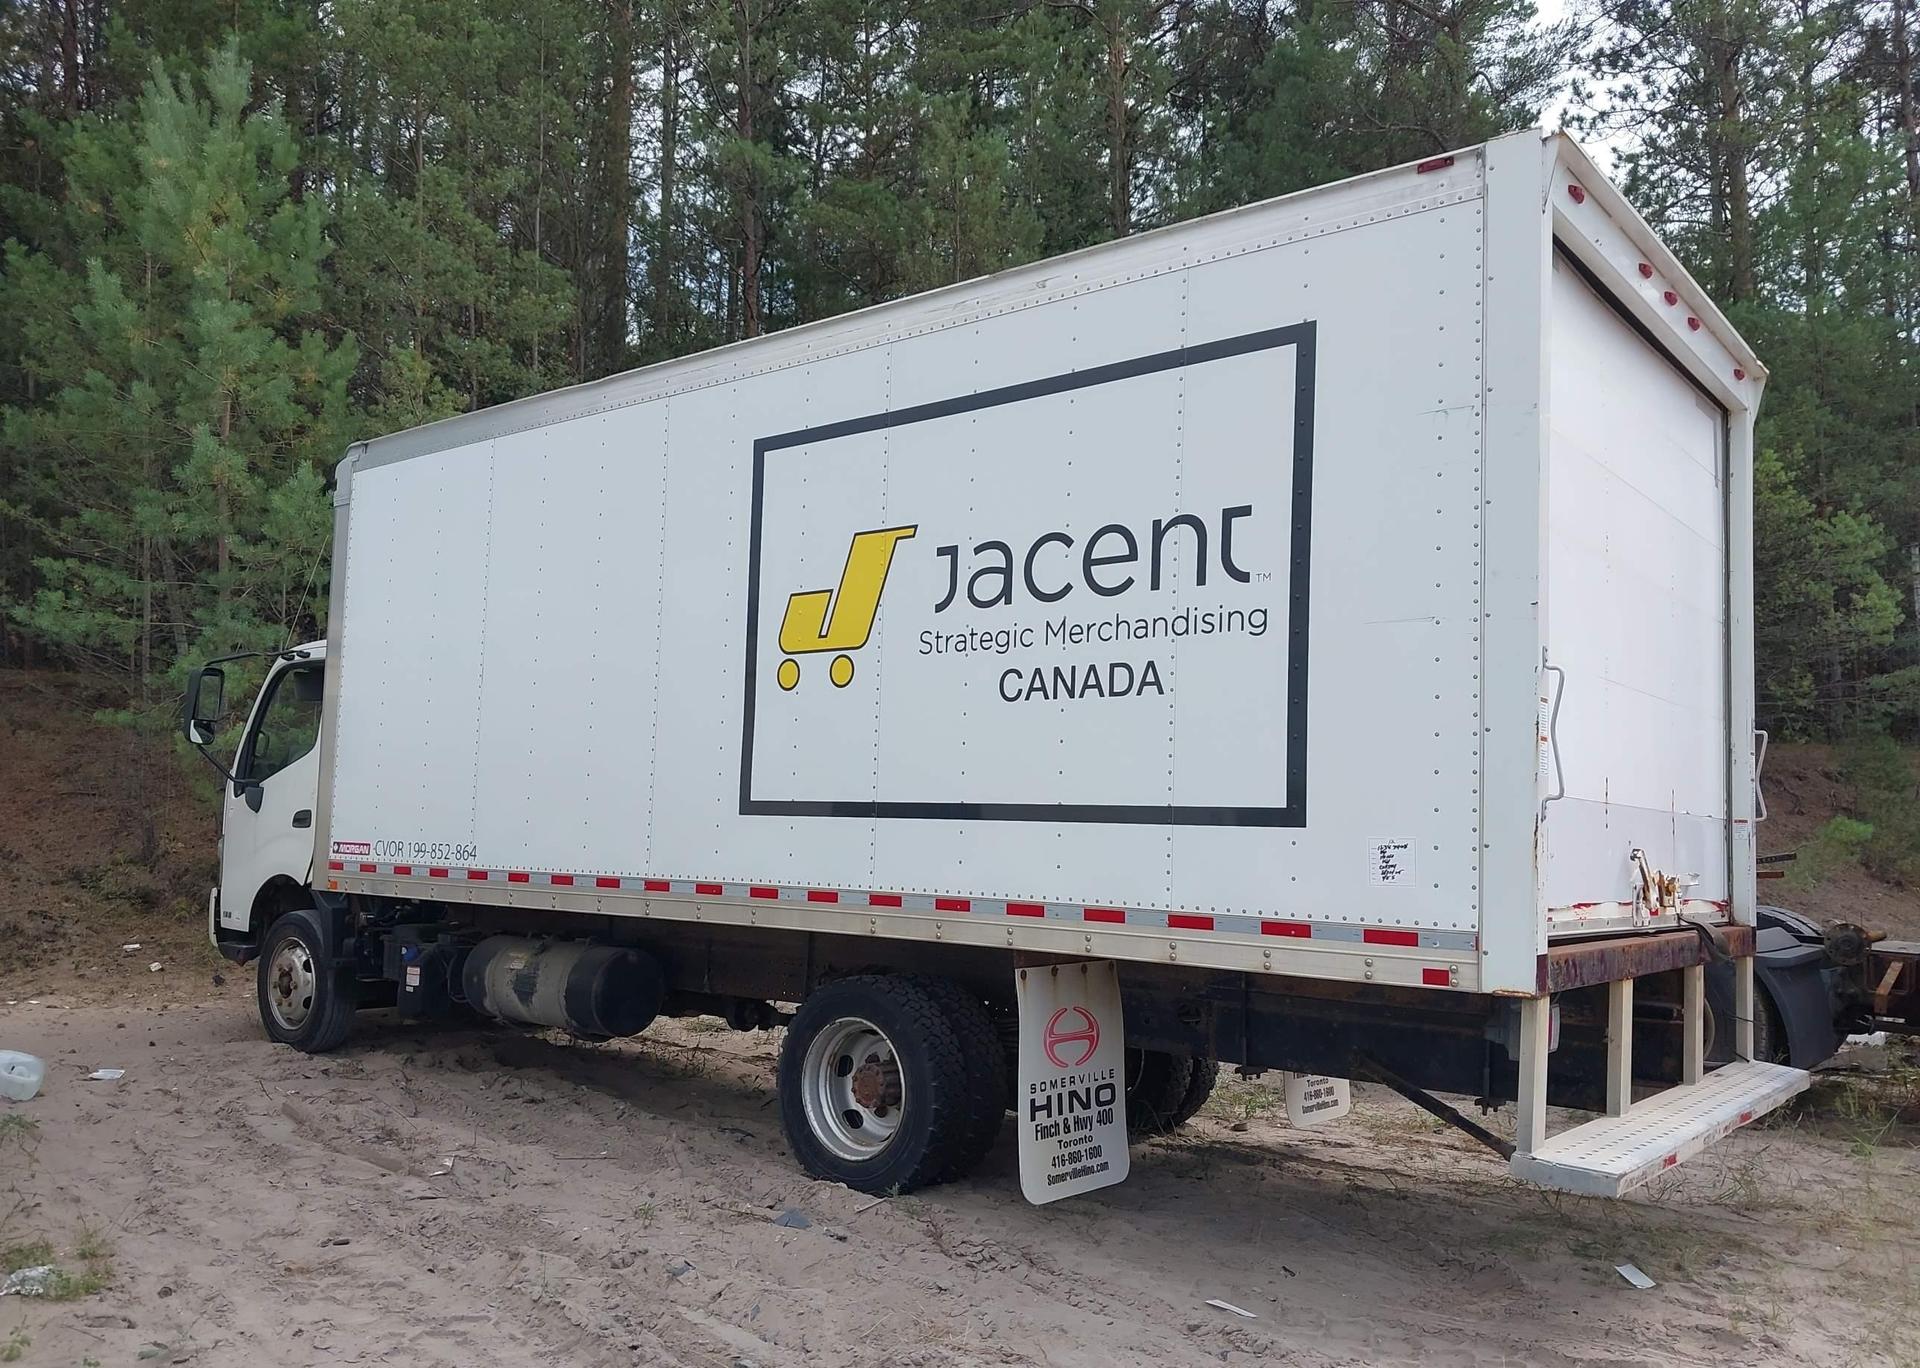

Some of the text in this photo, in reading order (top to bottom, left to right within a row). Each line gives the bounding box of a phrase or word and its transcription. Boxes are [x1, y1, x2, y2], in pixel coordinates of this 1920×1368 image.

[919, 605, 1268, 654] Strategic Merchandising
[999, 660, 1164, 702] CANADA
[339, 842, 370, 854] MORGAN
[375, 840, 477, 861] CVOR 199-852-864
[1030, 1069, 1115, 1094] SOMERVILLE
[1306, 1078, 1329, 1087] Toronto
[1030, 1083, 1116, 1122] HINO
[1035, 1108, 1114, 1141] Finch & Hwy 400
[1057, 1134, 1093, 1149] Toronto
[1051, 1145, 1102, 1168] 416-860-1600
[1047, 1161, 1110, 1186] SomervilleHino.com
